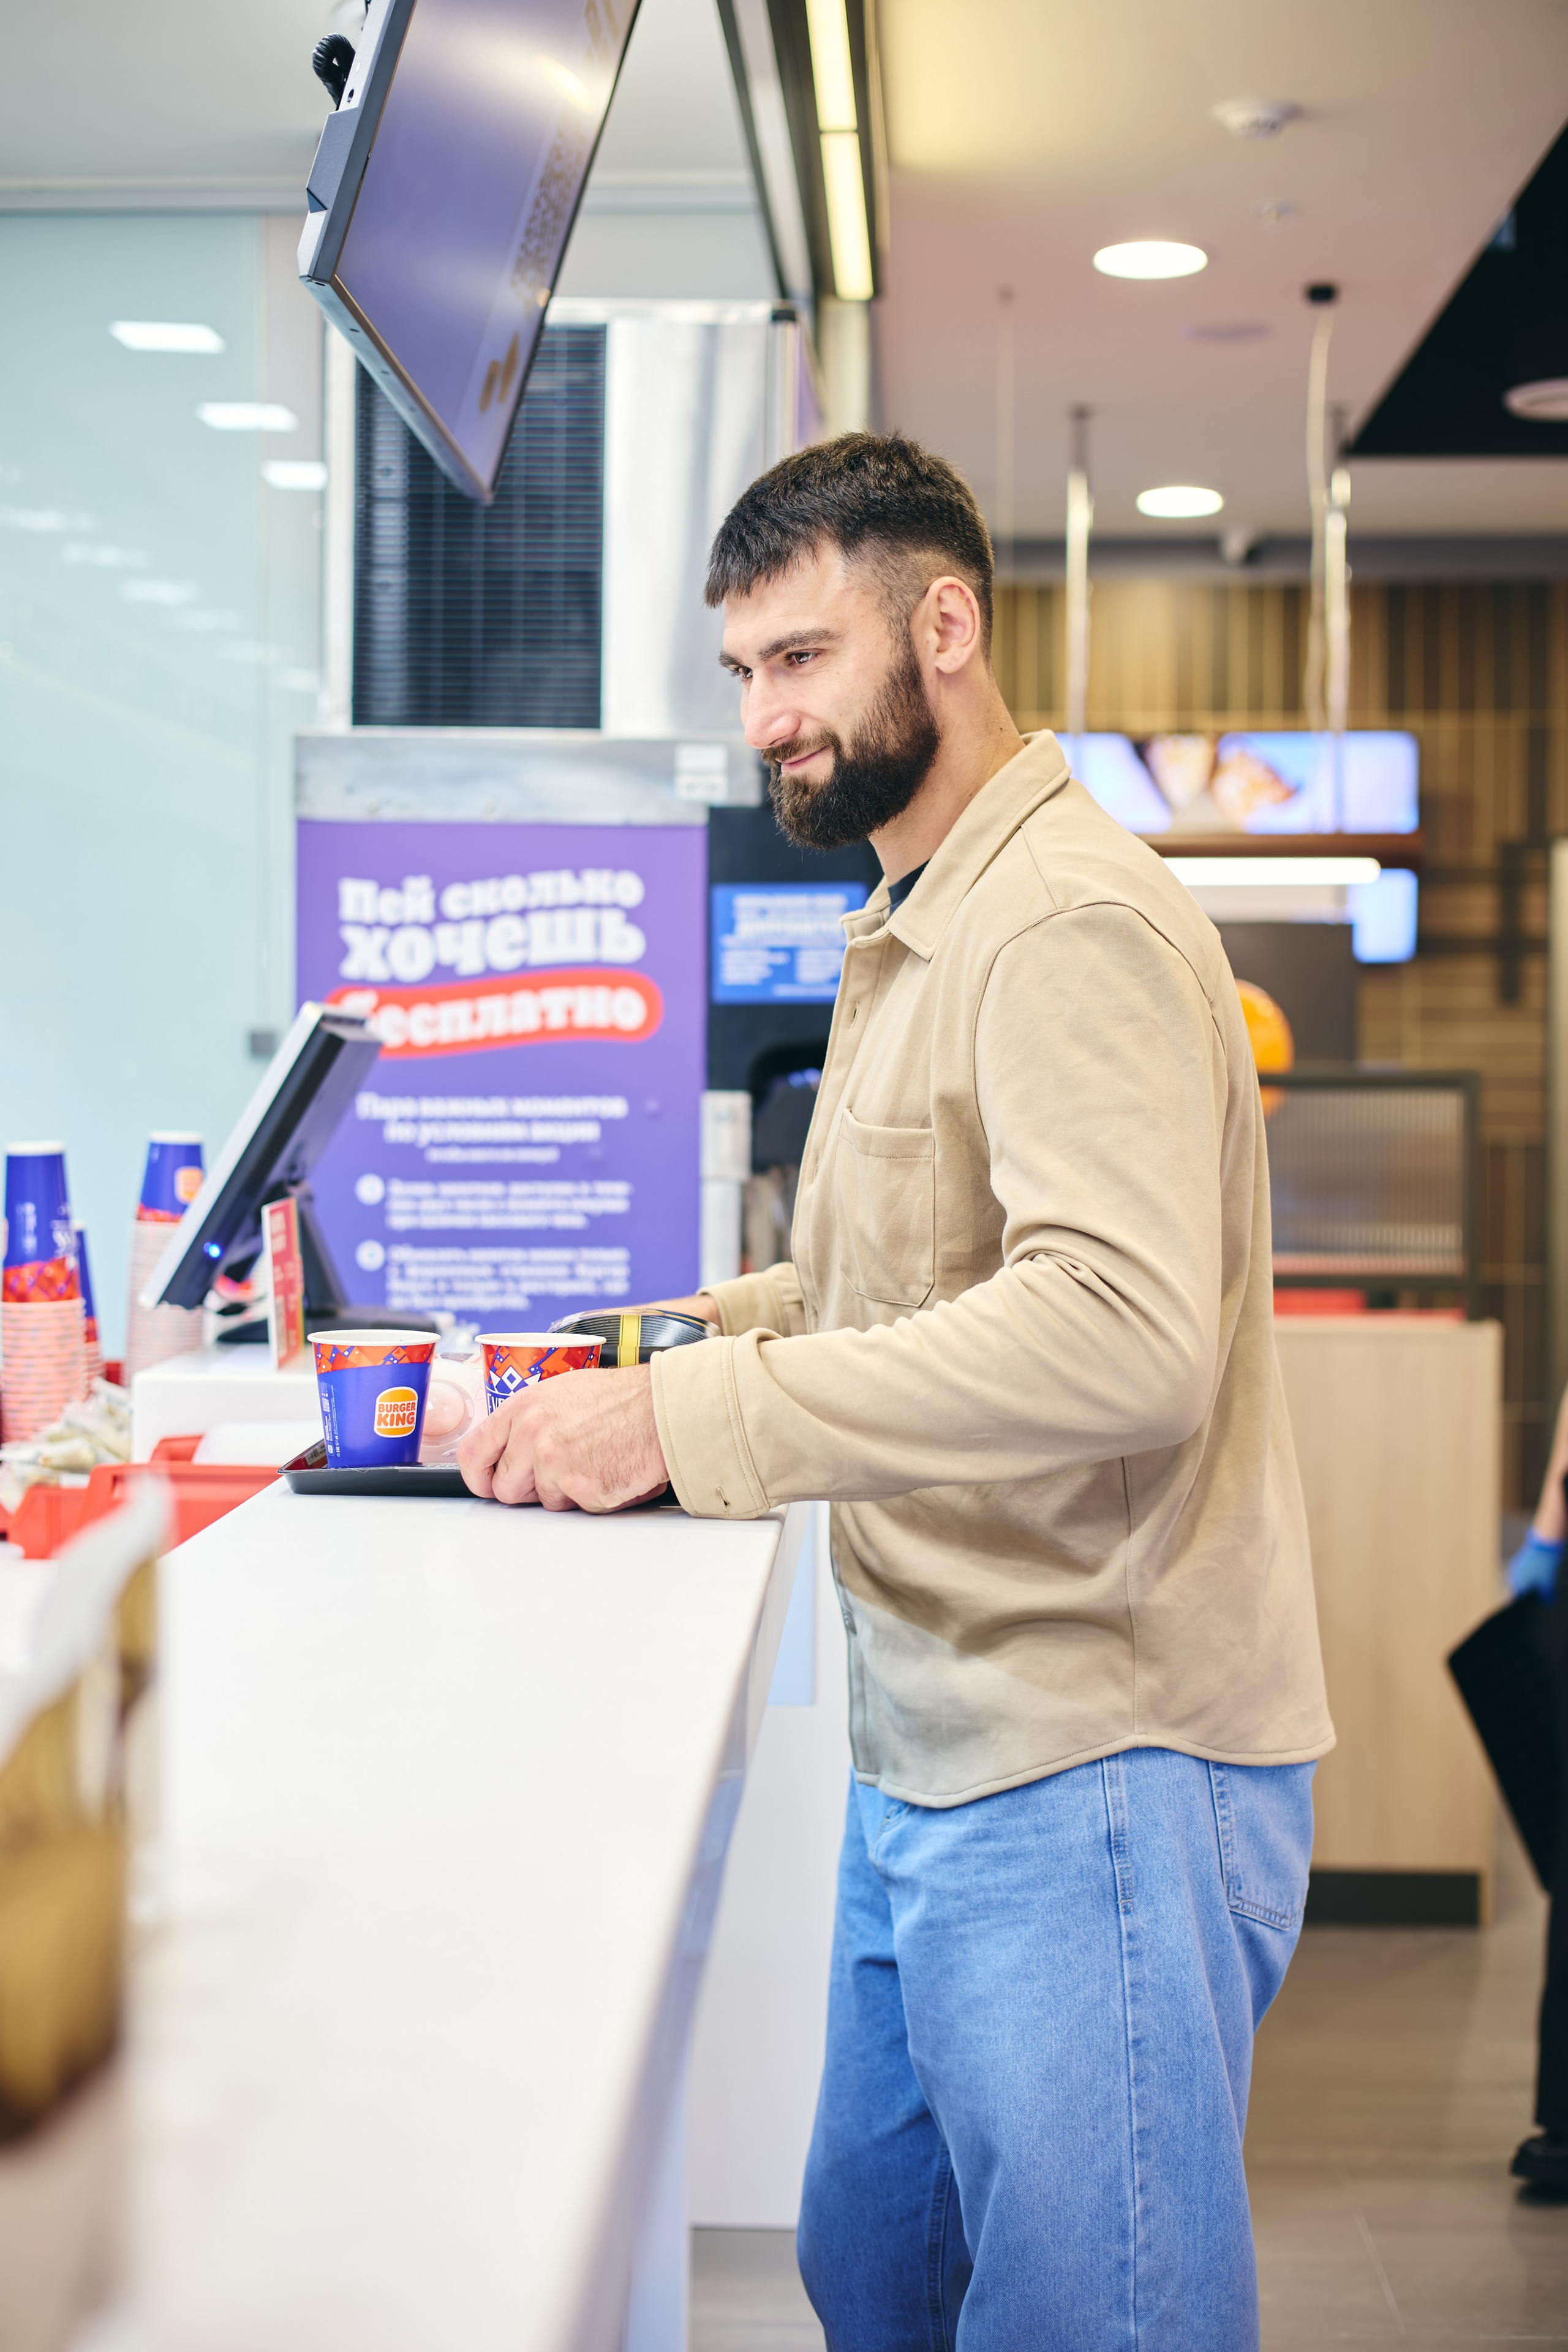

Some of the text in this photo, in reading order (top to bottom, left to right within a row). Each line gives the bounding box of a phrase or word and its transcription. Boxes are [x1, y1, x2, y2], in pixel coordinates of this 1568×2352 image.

[339, 869, 644, 925] Пей сколько
[339, 908, 646, 982] хочешь
[377, 1412, 415, 1427] KING
[378, 1402, 416, 1412] BURGER
